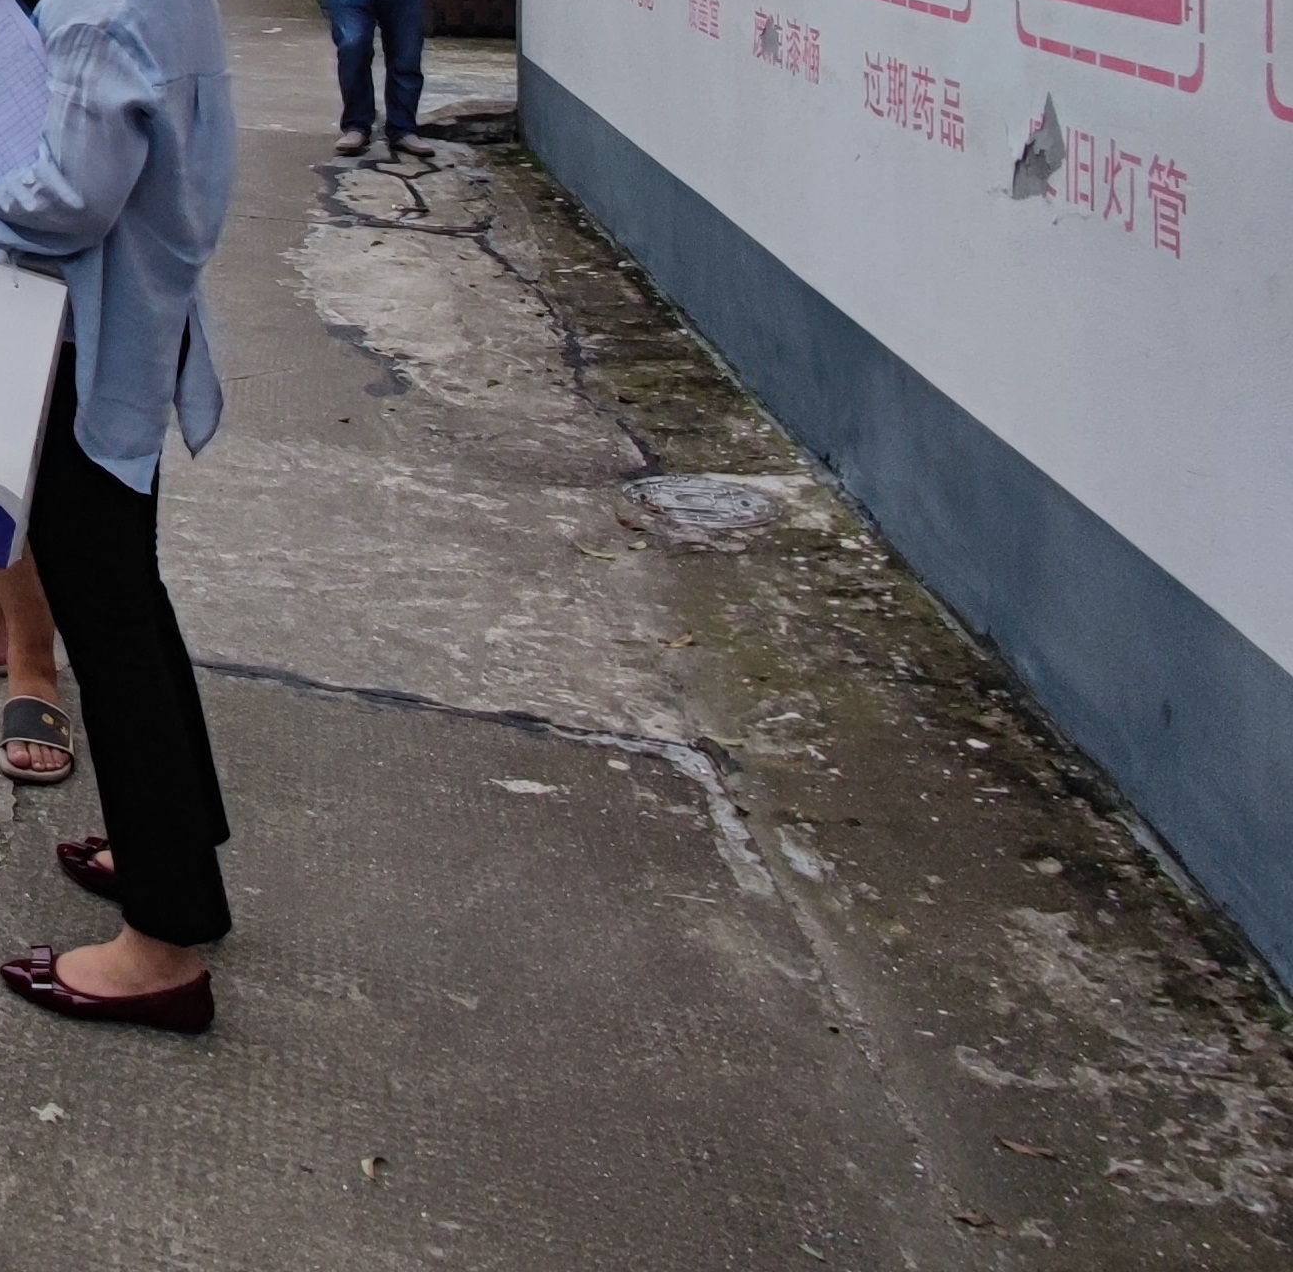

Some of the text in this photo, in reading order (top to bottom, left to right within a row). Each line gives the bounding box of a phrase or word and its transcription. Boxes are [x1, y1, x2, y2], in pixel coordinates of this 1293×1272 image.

[863, 51, 964, 152] 过期药品
[1027, 113, 1187, 259] 旧灯管
